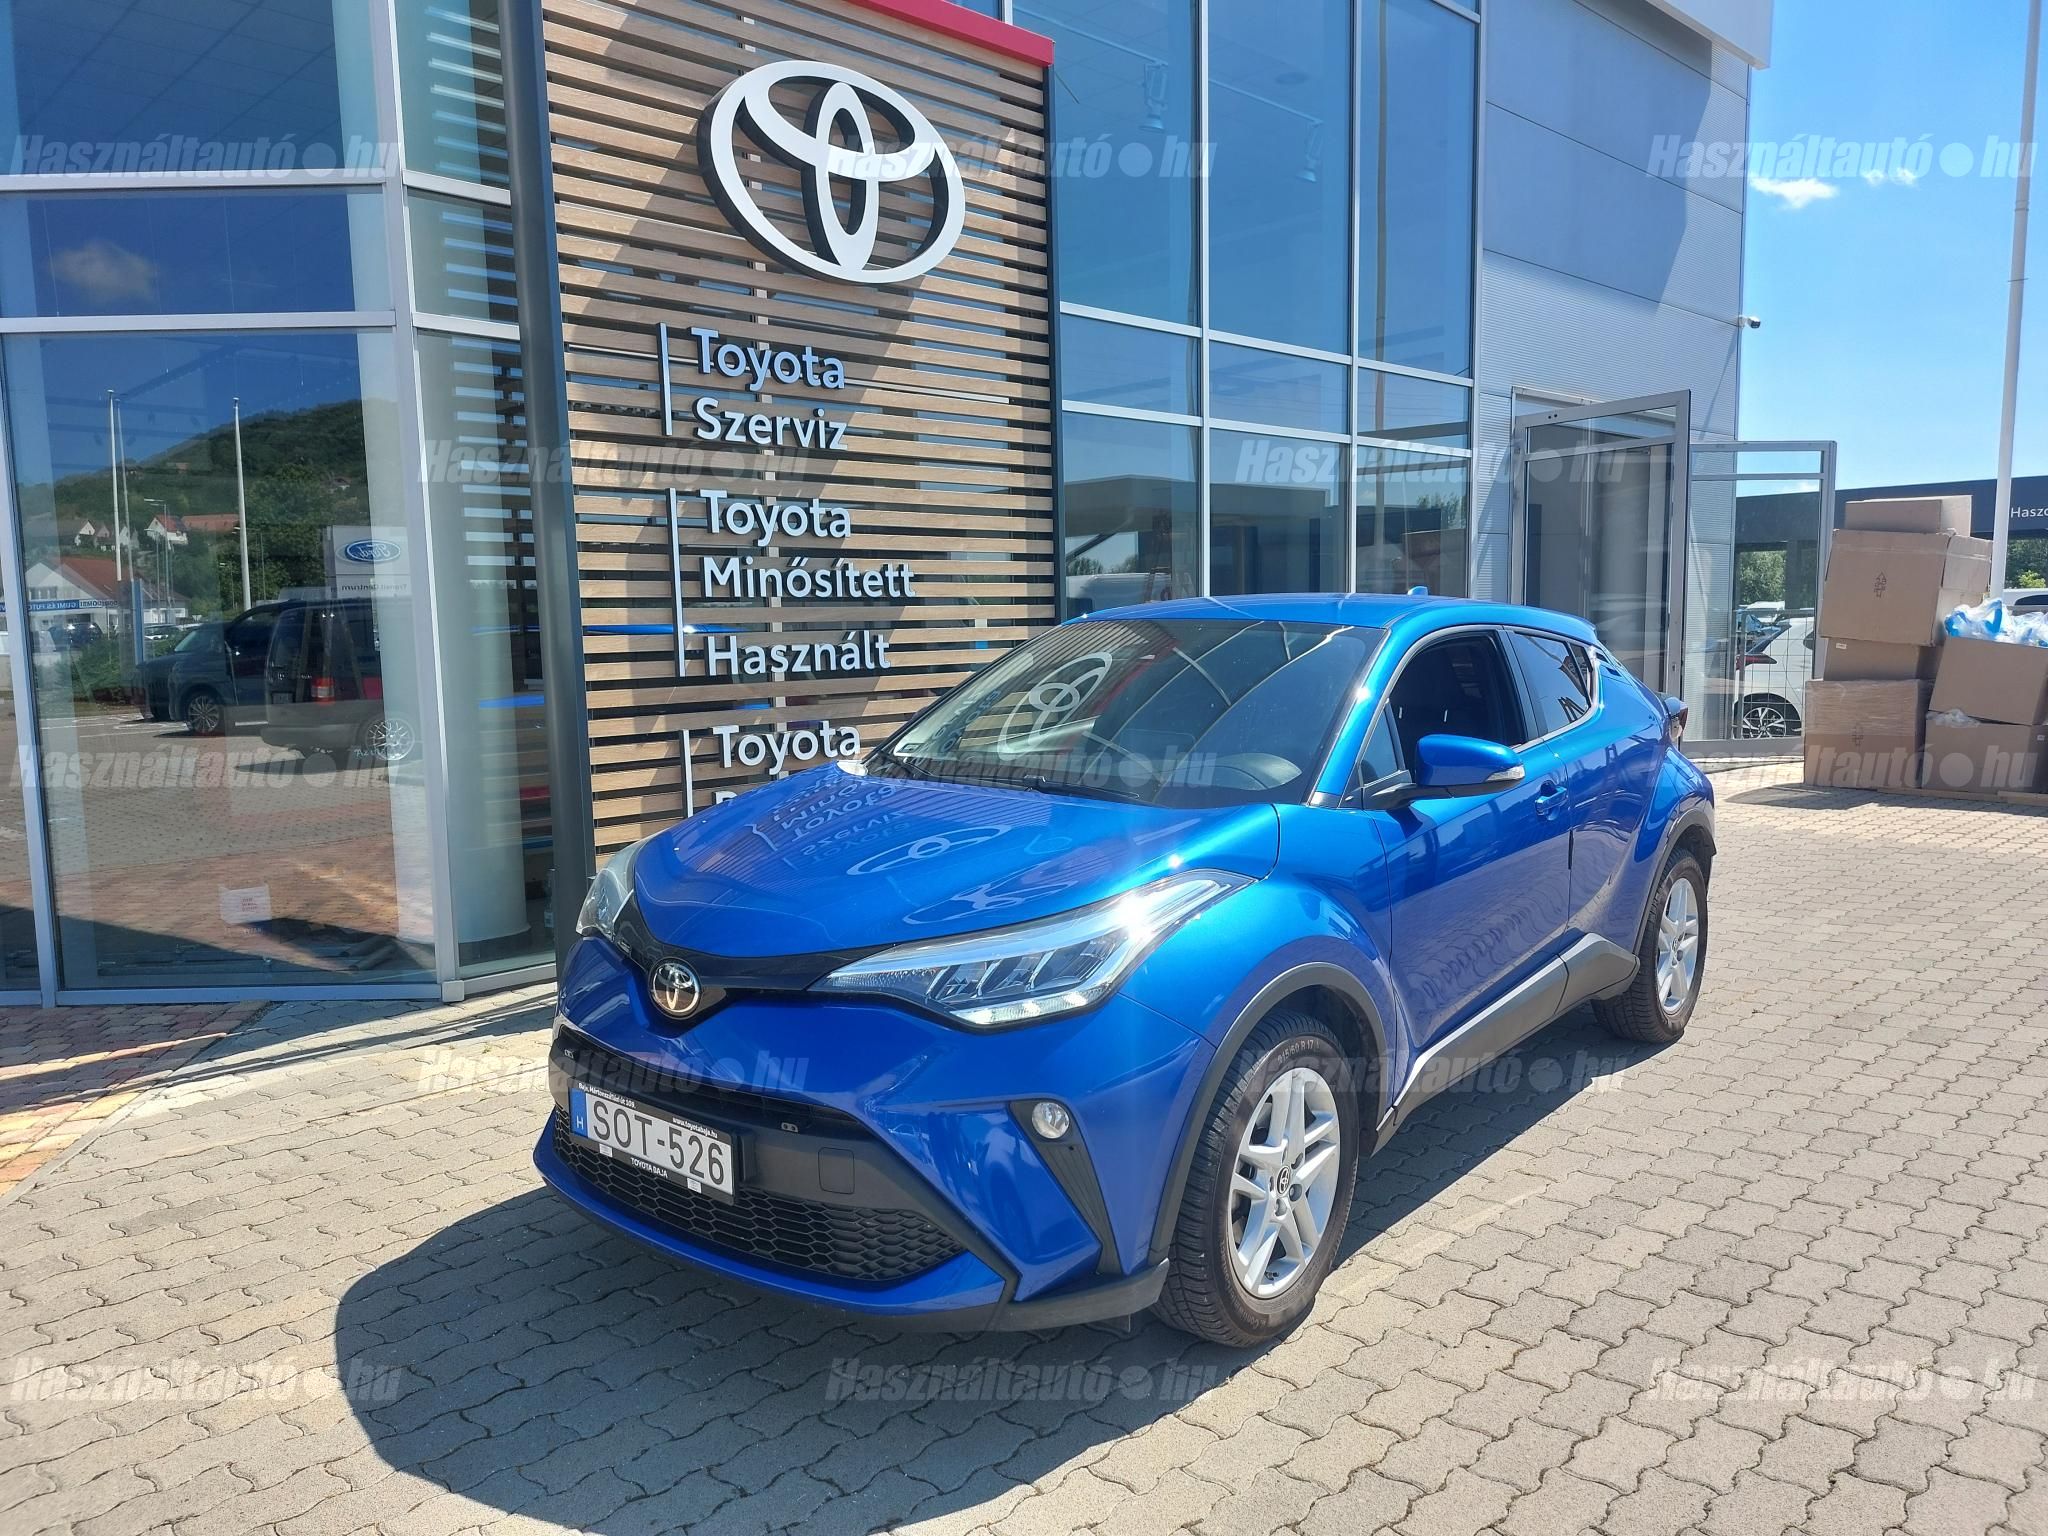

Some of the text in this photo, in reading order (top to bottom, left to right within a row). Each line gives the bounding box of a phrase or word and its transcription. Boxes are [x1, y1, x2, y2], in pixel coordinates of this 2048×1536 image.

[690, 327, 846, 391] Toyota
[694, 397, 848, 450] Szerviz
[700, 489, 851, 547] Toyota
[702, 556, 916, 599] Minősített
[706, 630, 892, 677] Használt
[713, 721, 861, 775] Toyota
[576, 1115, 584, 1130] H
[593, 1100, 725, 1186] SOT-526
[630, 1156, 669, 1179] TOYOTA BAJA
